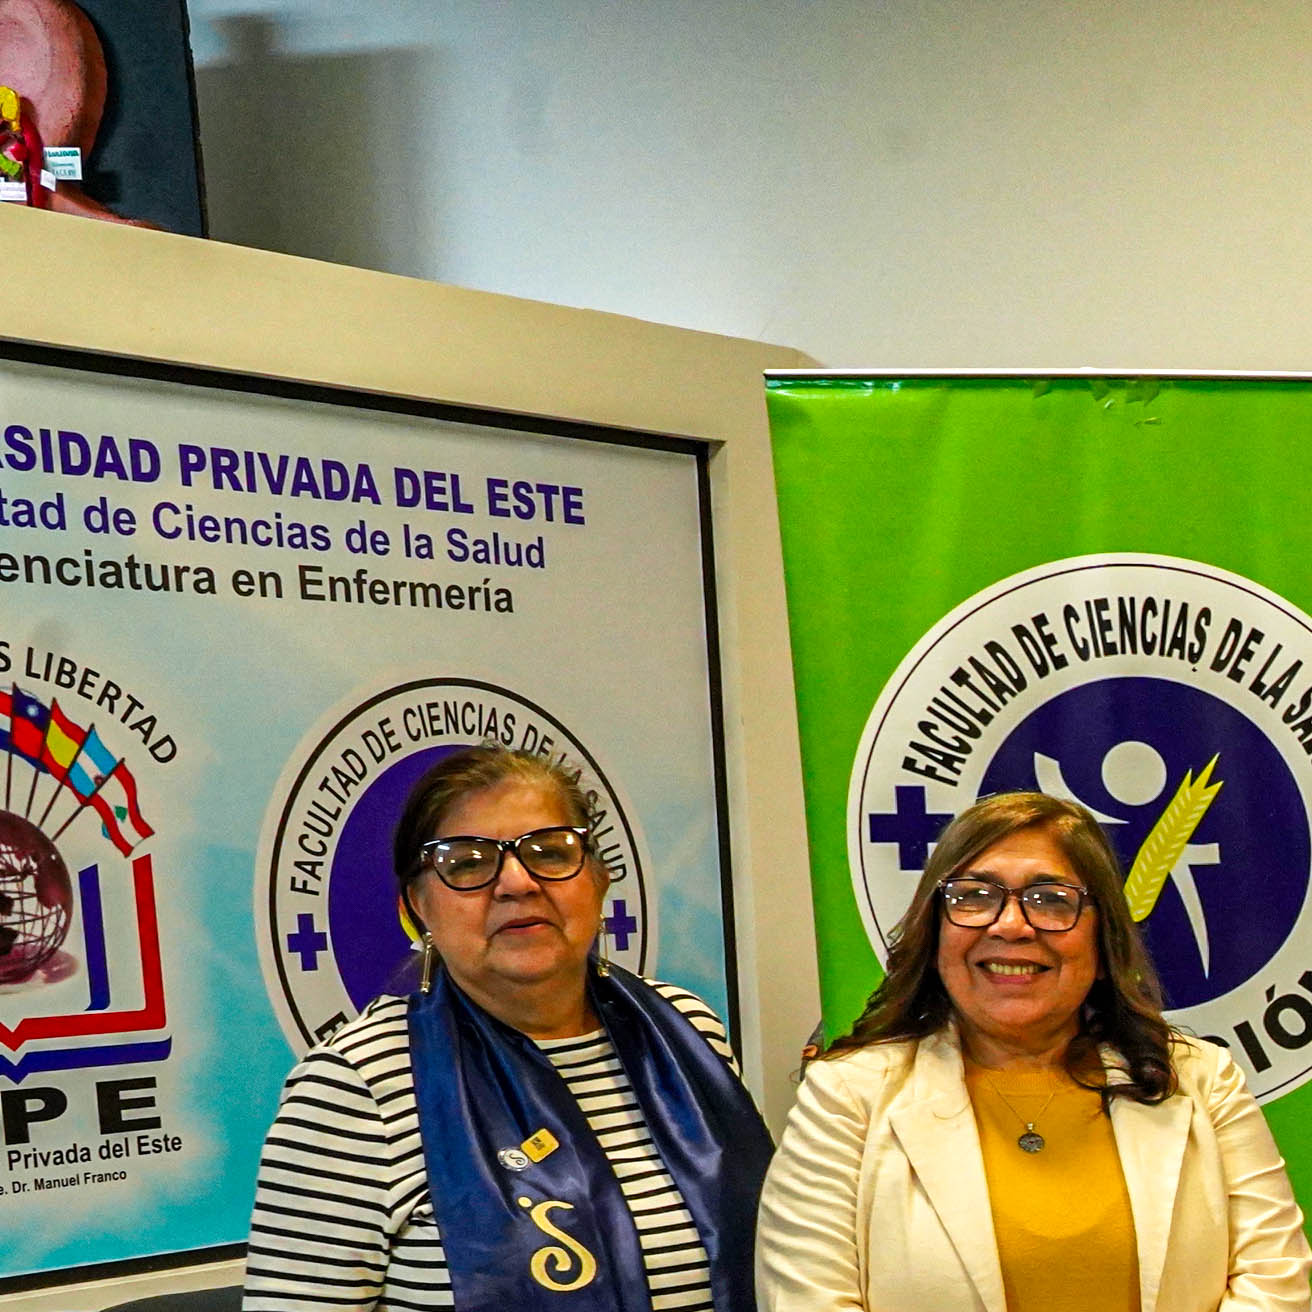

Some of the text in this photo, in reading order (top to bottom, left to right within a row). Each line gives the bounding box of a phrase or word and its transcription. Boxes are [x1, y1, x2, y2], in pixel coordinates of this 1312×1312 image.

[0, 425, 585, 525] SIDAD PRIVADA DEL ESTE
[84, 497, 137, 536] de
[152, 501, 331, 551] Ciencias
[346, 520, 390, 555] de
[403, 524, 434, 559] la
[447, 527, 545, 568] Salud
[0, 549, 514, 613] enciatura en Enfermería
[25, 647, 178, 764] LIBERTAD
[901, 640, 1029, 788] FACULTAD
[1011, 612, 1070, 680] DE
[1062, 596, 1213, 663] CIENCIAS
[1209, 617, 1266, 683] DE
[1248, 643, 1304, 710] LA
[290, 748, 368, 897] FACULTAD
[361, 717, 403, 764] DE
[402, 700, 517, 746] CIENCIAS
[0, 1076, 162, 1146] PE
[8, 1134, 183, 1171] Privada del Este
[12, 1181, 30, 1194] Dr.
[34, 1174, 80, 1191] Manuel
[84, 1170, 127, 1185] Franco
